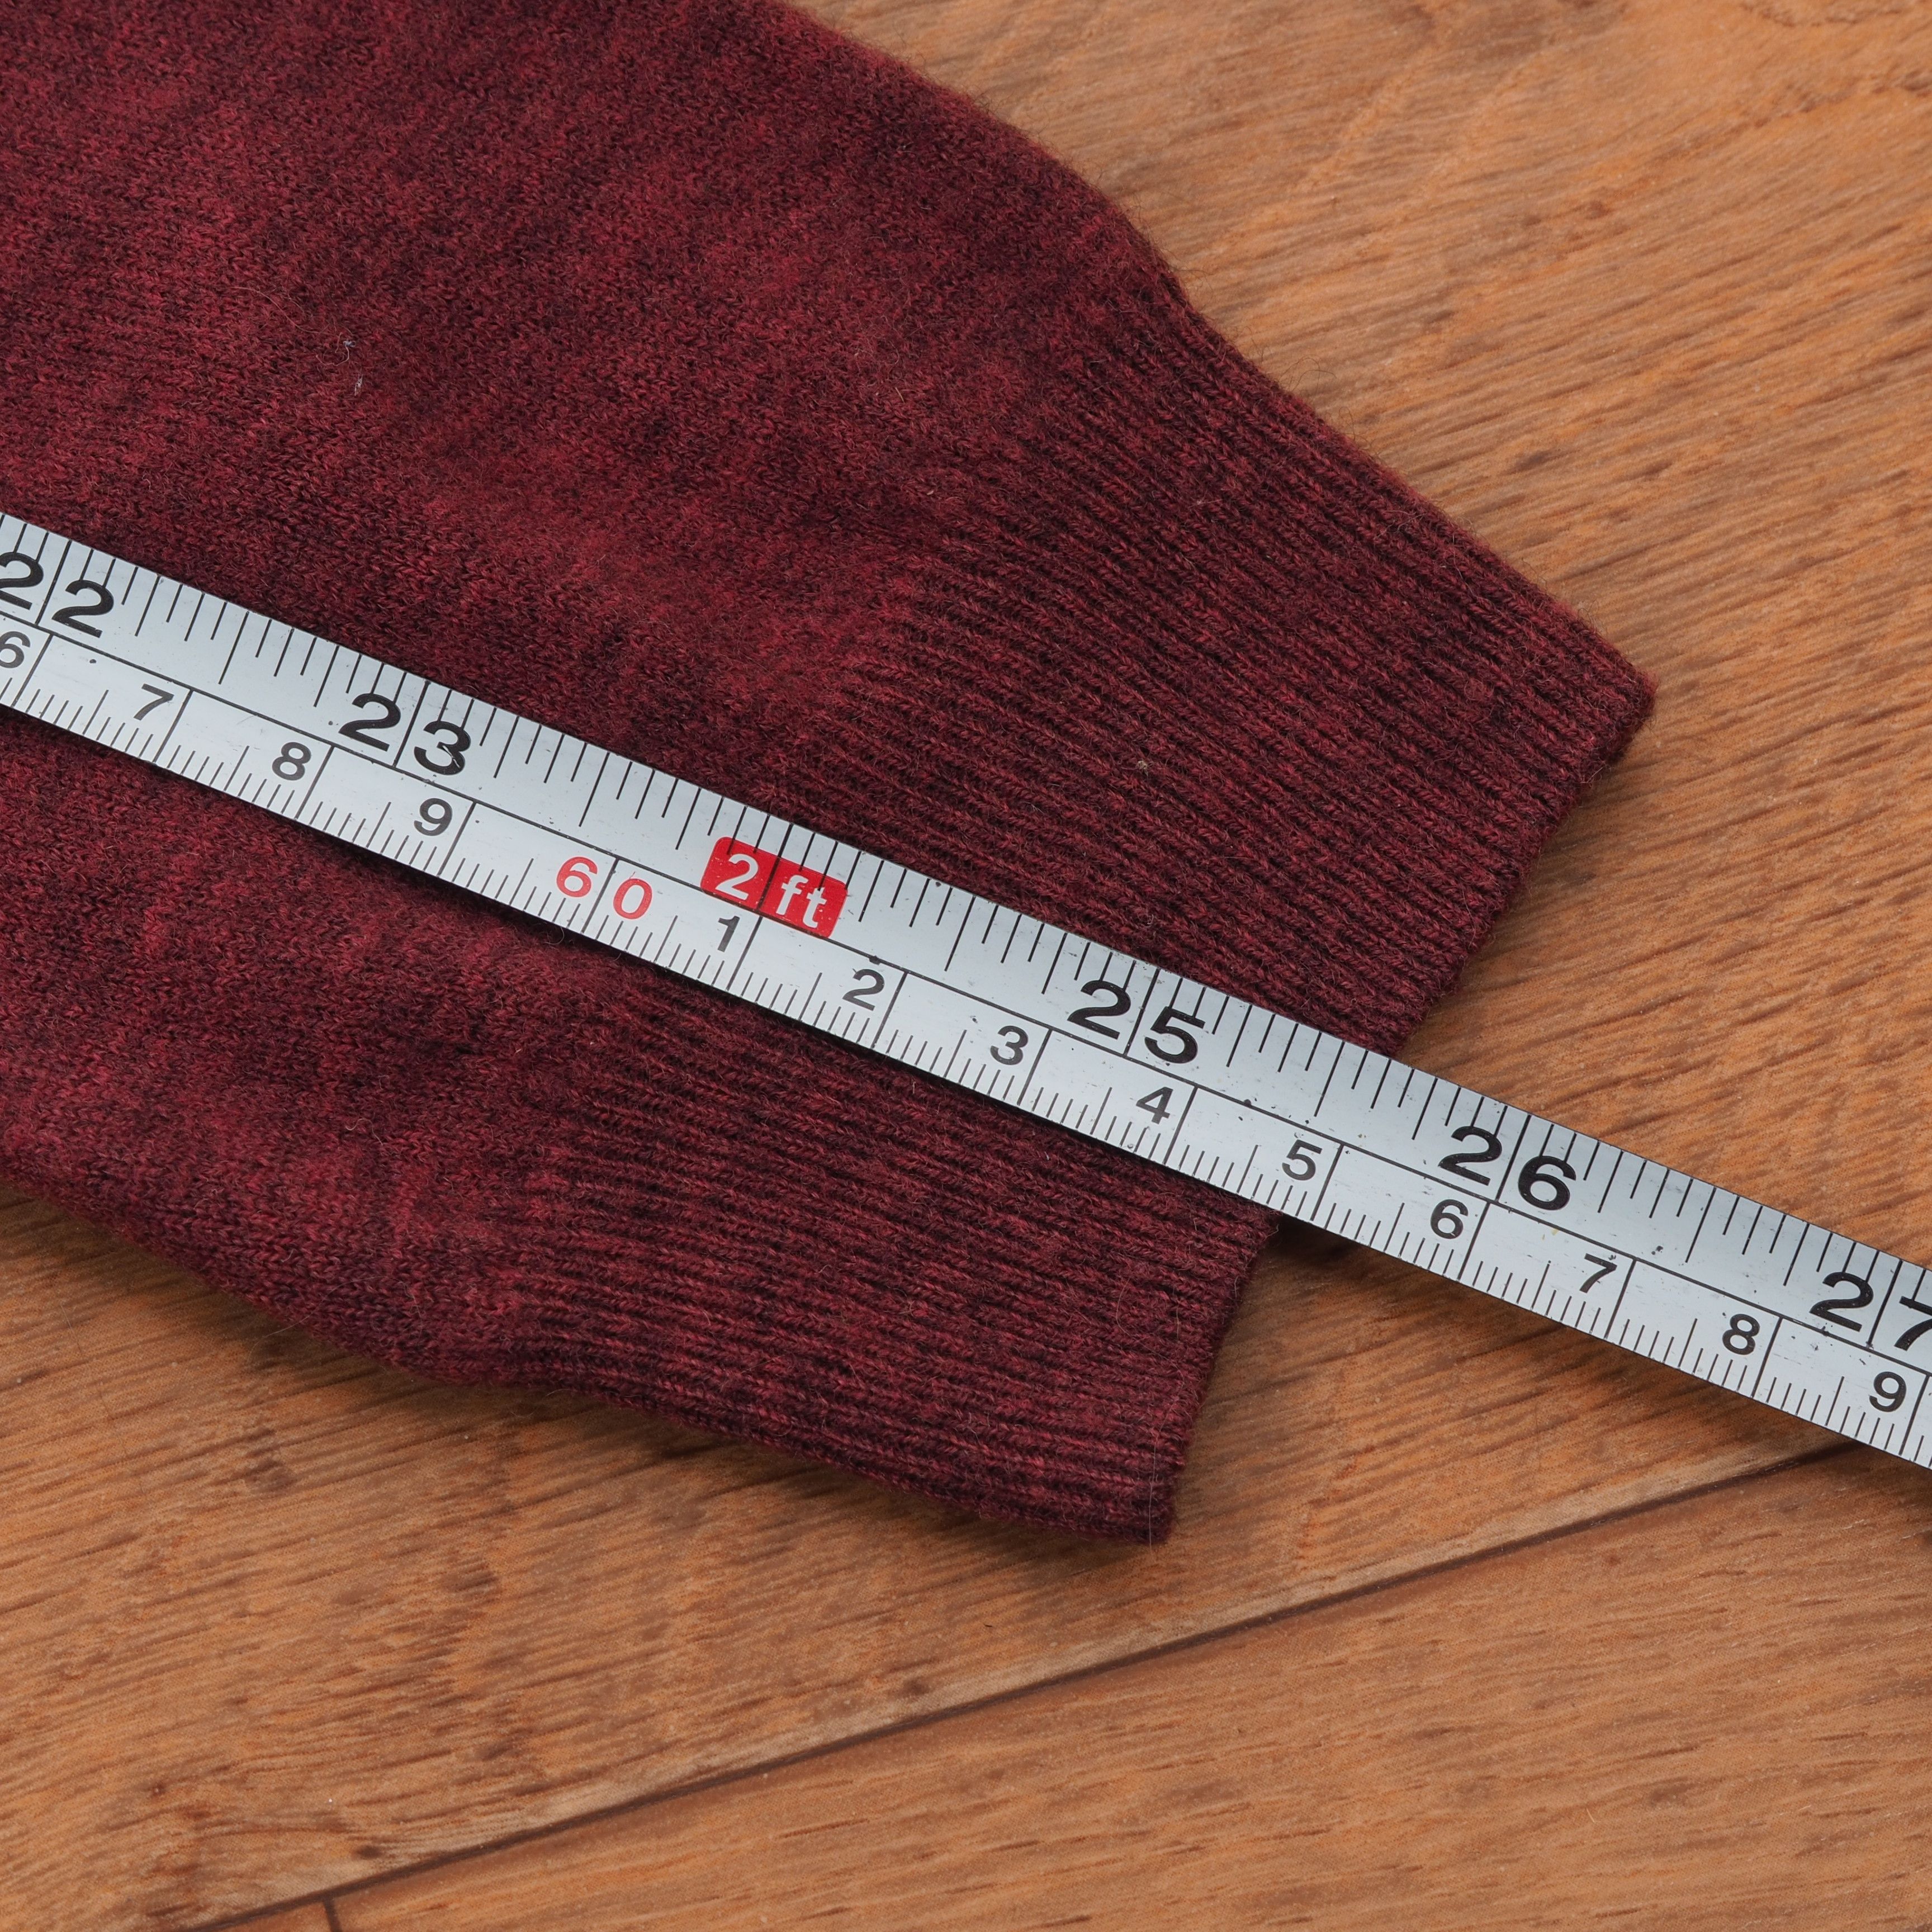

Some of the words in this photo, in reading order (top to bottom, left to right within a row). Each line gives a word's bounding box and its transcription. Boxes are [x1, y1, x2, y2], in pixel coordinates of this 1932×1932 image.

[0, 631, 31, 669] 6
[133, 683, 174, 721] 7
[272, 742, 312, 780] 8
[413, 798, 453, 836] 9
[717, 915, 740, 953] 1
[842, 969, 886, 1011] 2
[989, 1025, 1029, 1066] 3
[1136, 1087, 1173, 1125] 4
[1282, 1139, 1323, 1181] 5
[1429, 1199, 1469, 1239] 6
[1579, 1253, 1617, 1294] 7
[1722, 1314, 1760, 1356] 8
[1869, 1371, 1907, 1413] 9
